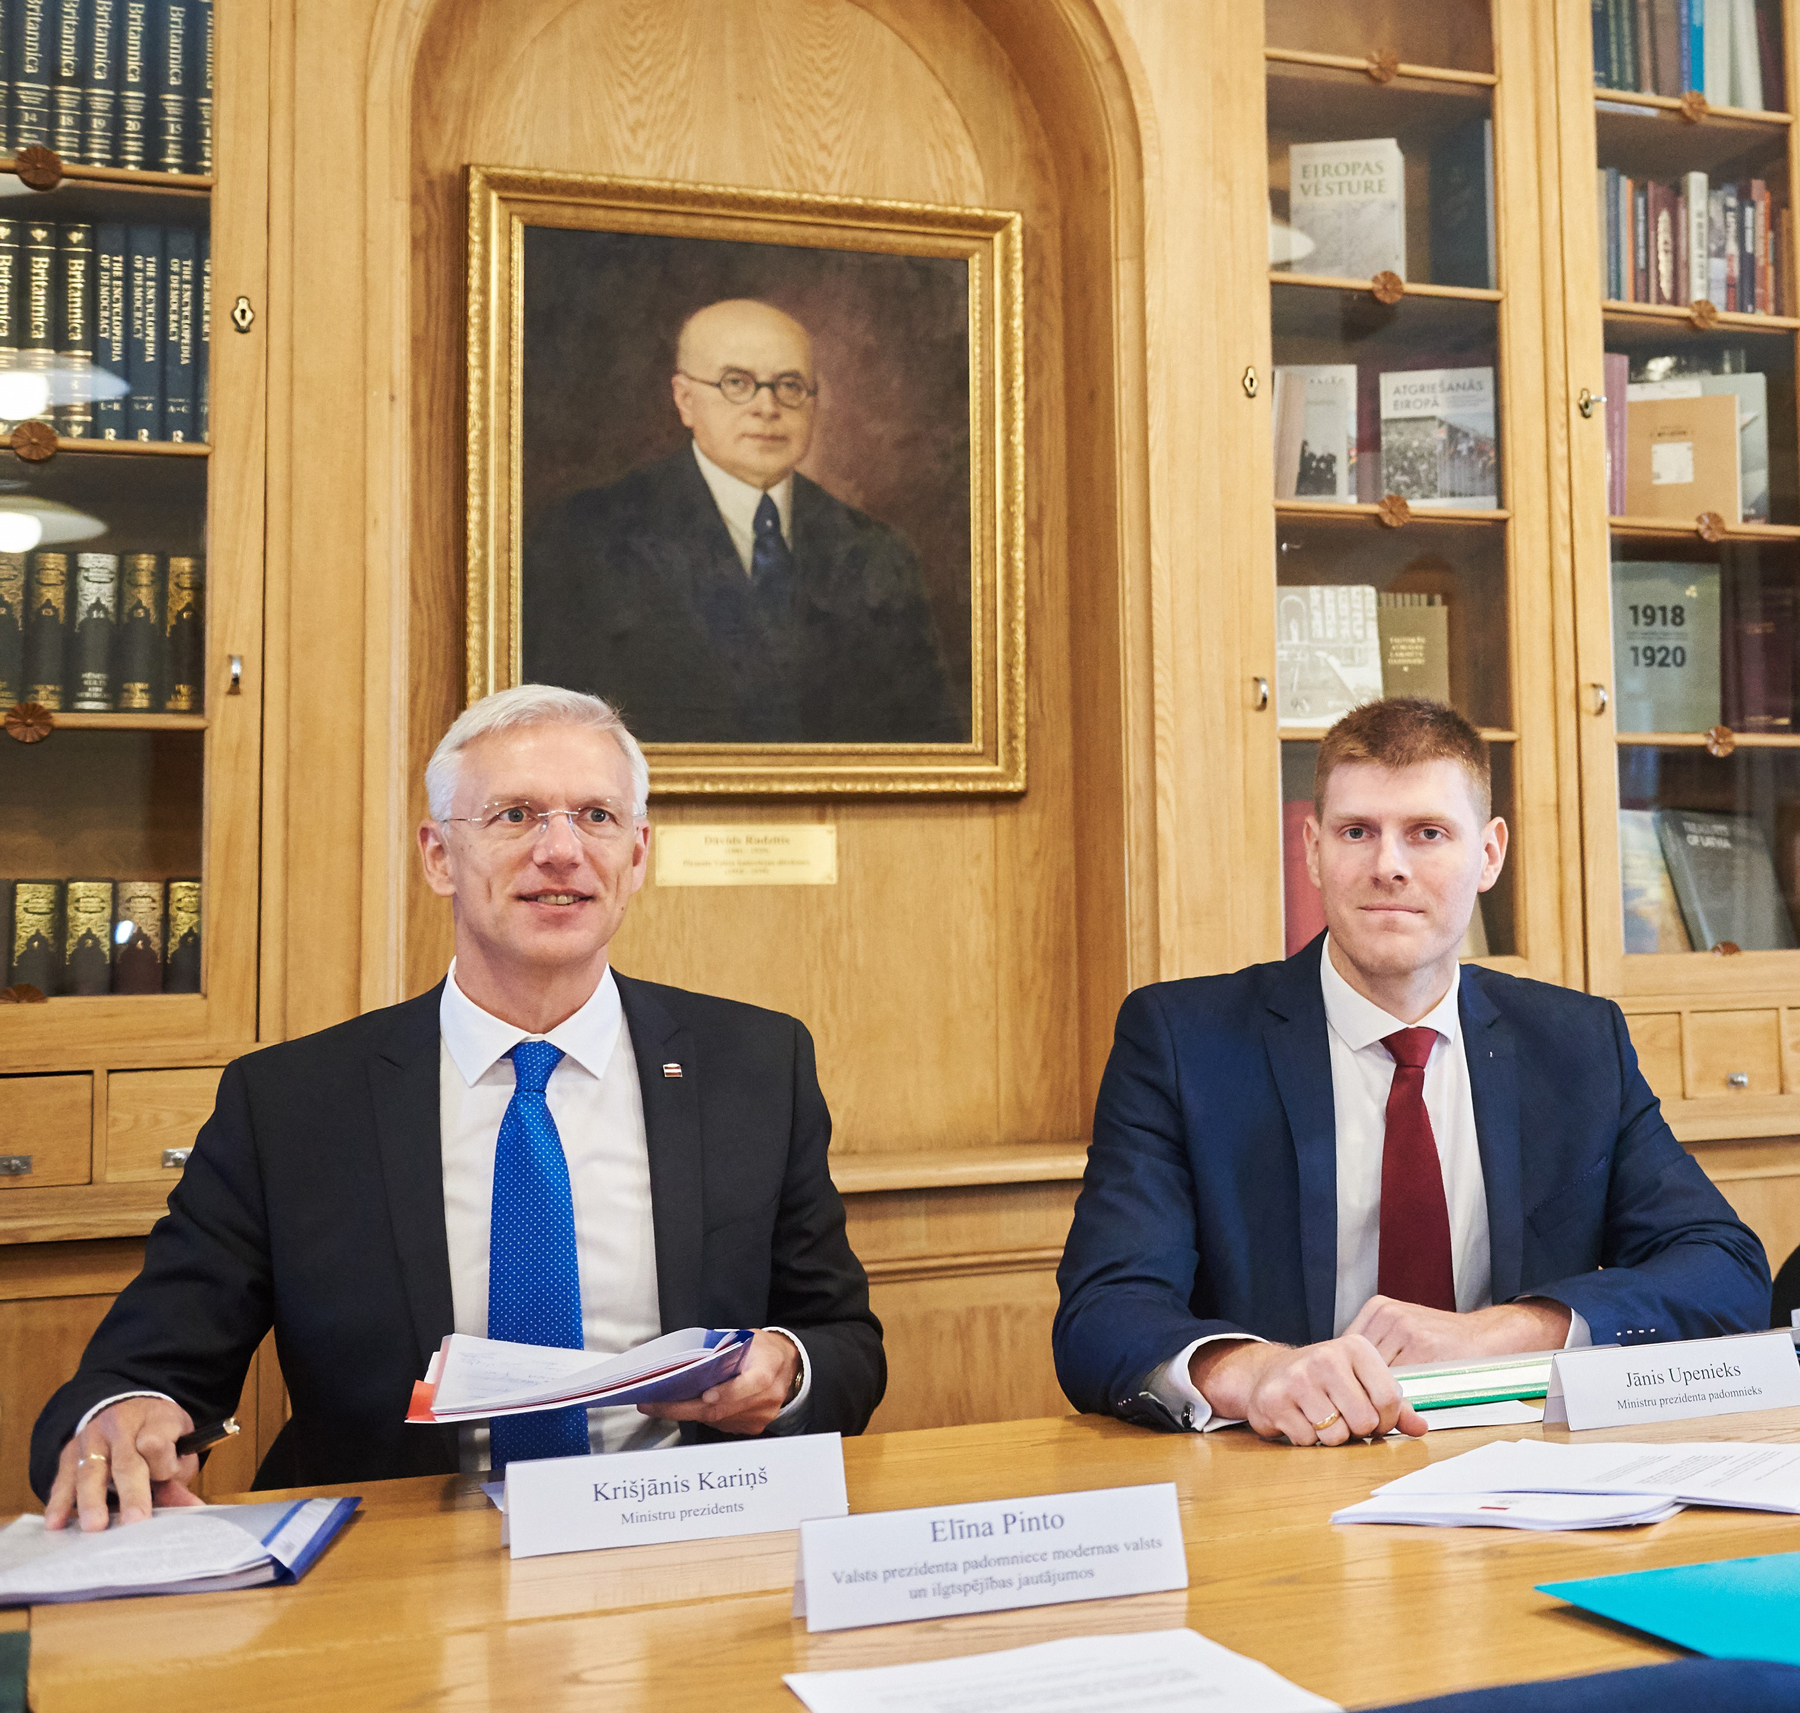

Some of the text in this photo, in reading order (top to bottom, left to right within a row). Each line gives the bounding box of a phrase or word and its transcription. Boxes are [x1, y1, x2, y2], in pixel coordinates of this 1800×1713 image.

[93, 0, 113, 80] Britannica
[126, 2, 146, 83] Britannica
[169, 5, 186, 86] Britannica
[22, 111, 38, 123] 14
[59, 114, 74, 126] 18
[92, 118, 106, 130] 19
[125, 120, 141, 131] 20
[169, 123, 183, 135] 15
[1302, 161, 1383, 179] EIROPAS
[0, 254, 13, 338] Britannica
[31, 256, 50, 340] Britannica
[67, 258, 86, 342] Britannica
[99, 253, 111, 340] OF DEMOCRACY
[111, 254, 124, 363] THE ENCYCLOPEDIA
[133, 254, 144, 340] OF DEMOCRACY
[145, 256, 158, 363] THE ENCYCLOPEDIA
[168, 258, 180, 343] OF DEMOCRACY
[180, 259, 193, 366] THE ENCYCLOPEDIA
[1393, 380, 1484, 396] ATGRIEŠANĀS
[1628, 604, 1686, 627] 1918
[1630, 646, 1687, 668] 1920
[1626, 1362, 1742, 1388] Jānis Upenieks
[1617, 1386, 1763, 1410] Ministru prezidenta padomnieks
[592, 1466, 769, 1504] Krišjānis Kariņš
[620, 1501, 745, 1525] Ministru prezidents
[930, 1511, 1066, 1543] Elīna Pinto
[832, 1535, 1163, 1586] Valsts prezidenta padomniece modernas valsts
[908, 1567, 1095, 1601] un ilgtspējības jautājumos
